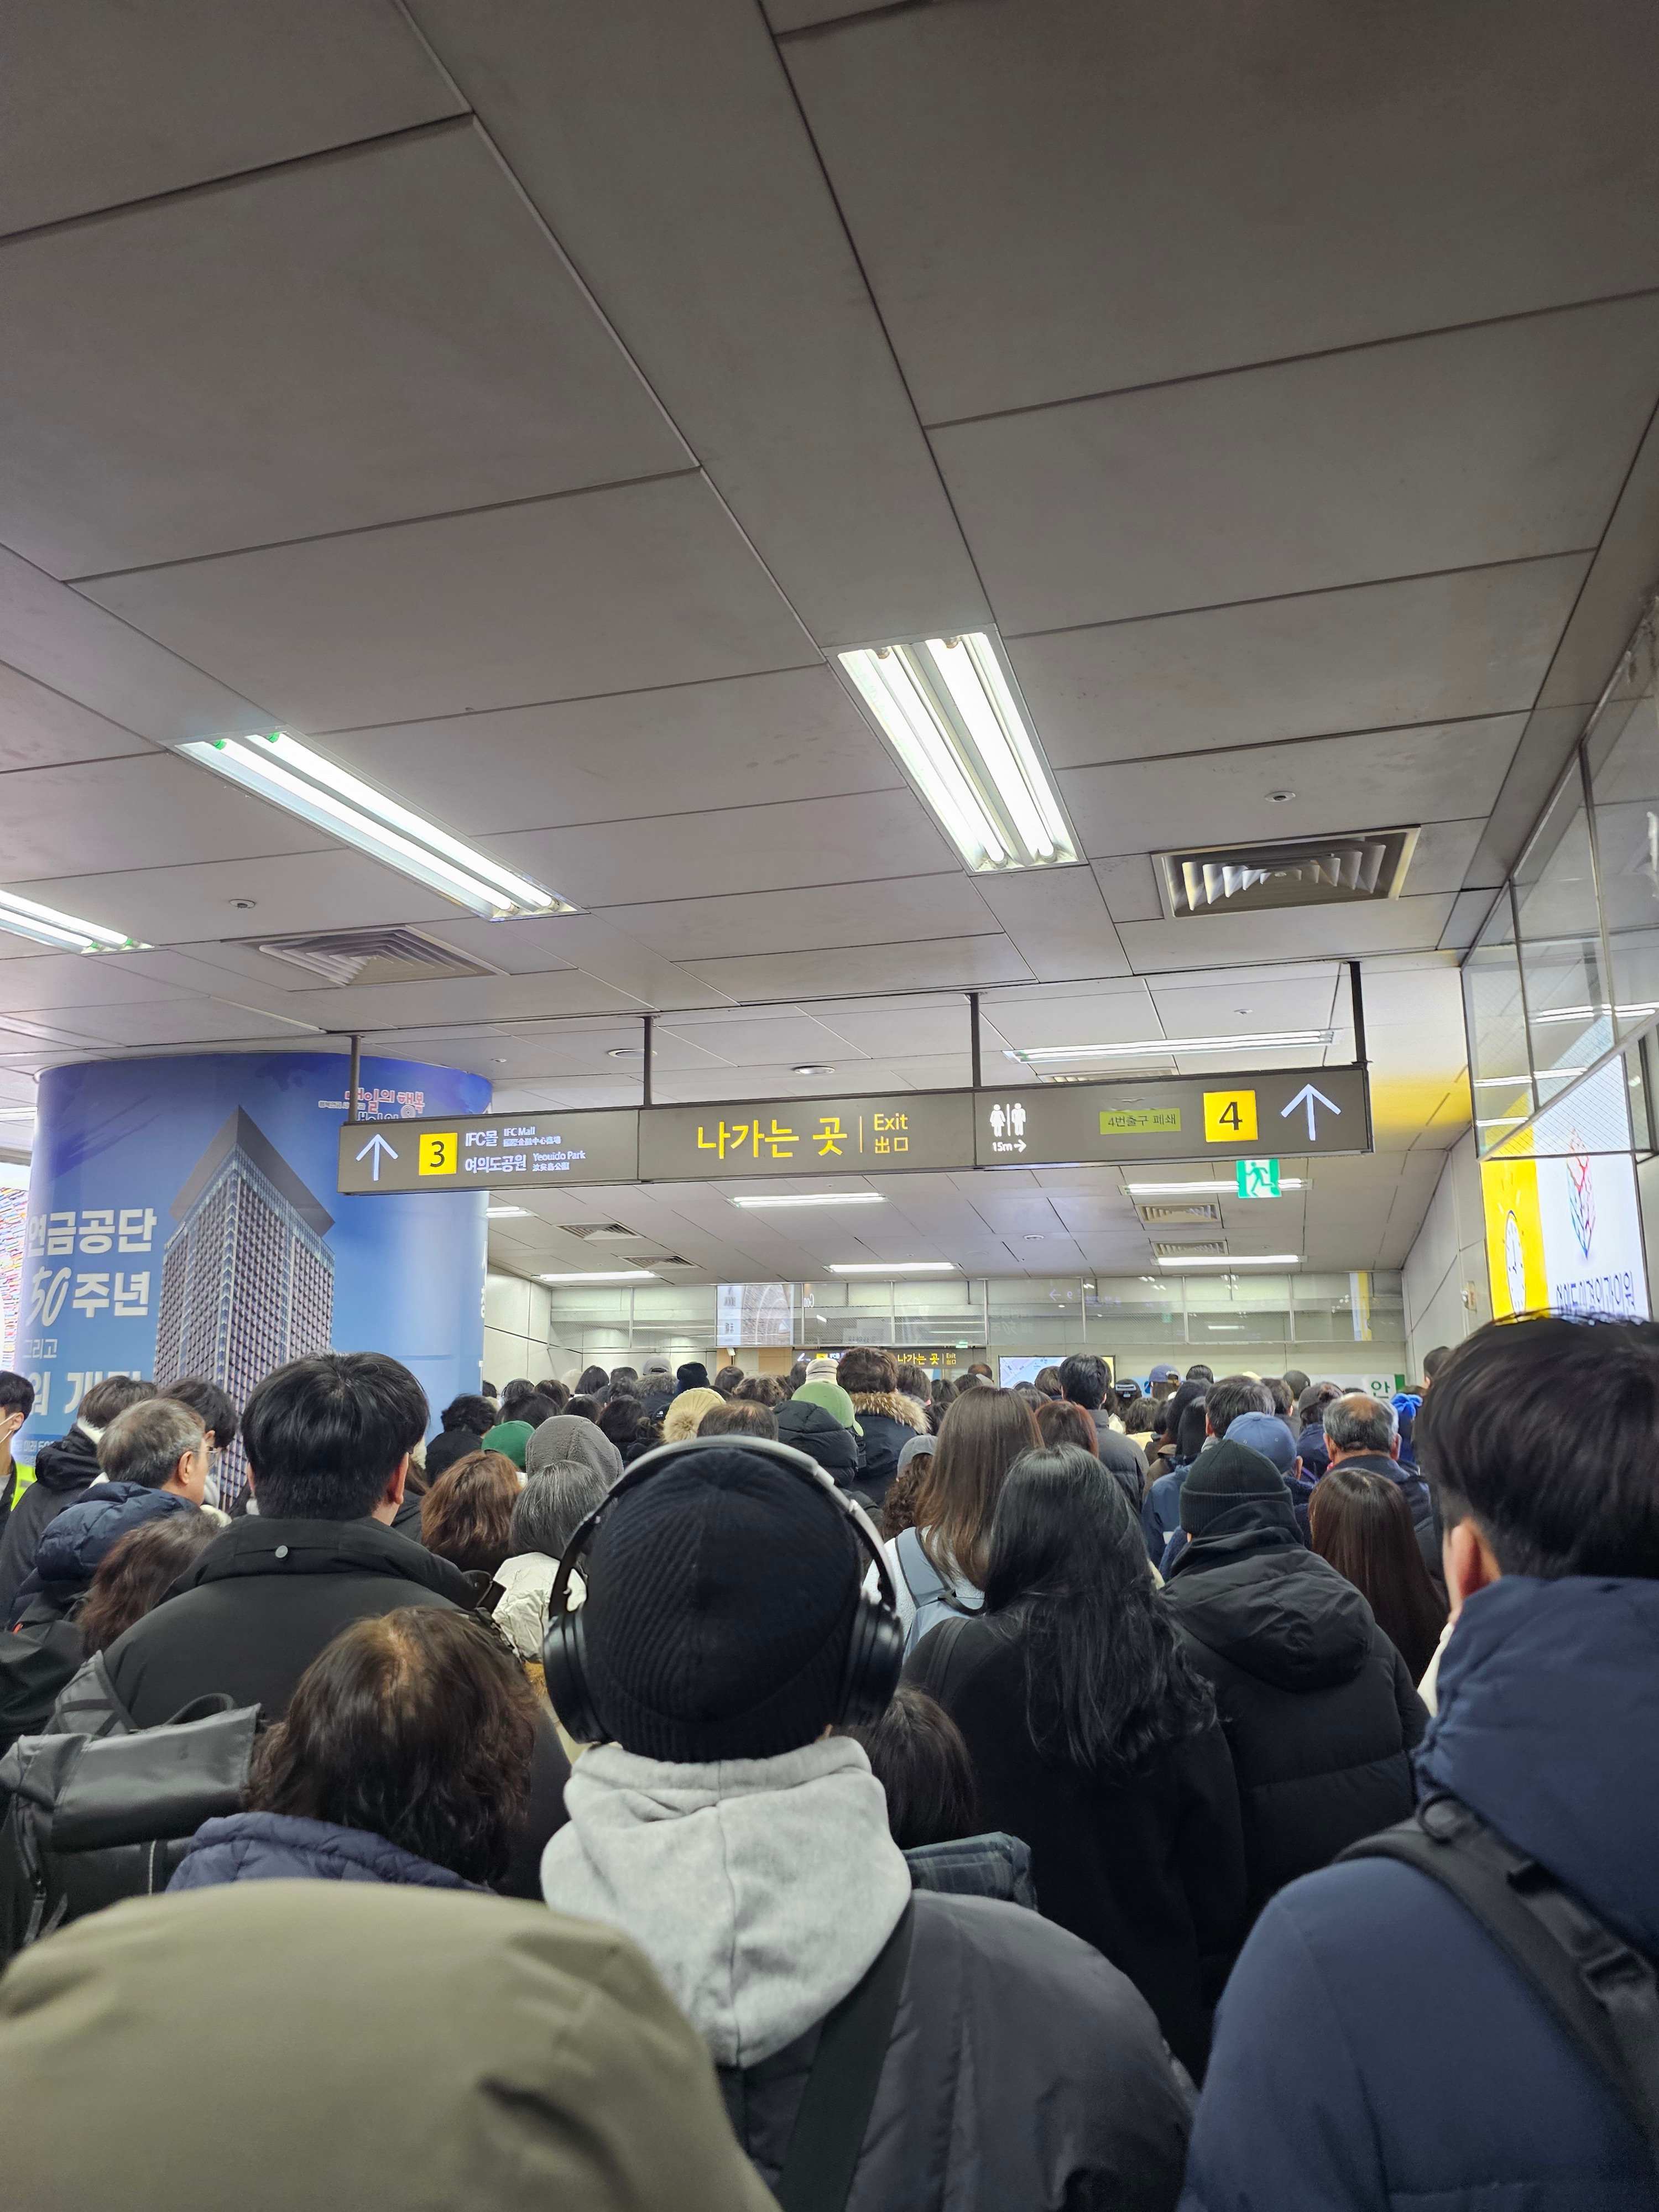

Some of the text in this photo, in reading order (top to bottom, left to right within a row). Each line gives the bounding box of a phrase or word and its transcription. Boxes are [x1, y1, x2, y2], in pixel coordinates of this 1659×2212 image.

[874, 1113, 908, 1131] Exit
[1108, 1113, 1176, 1127] 4번출구 폐쇄
[1219, 1102, 1243, 1130] 4
[465, 1130, 498, 1147] IFC몰
[504, 1126, 536, 1136] IFC Mall
[698, 1117, 847, 1159] 나가는 곳
[874, 1135, 909, 1154] 出口
[993, 1141, 1013, 1152] 15m
[430, 1141, 445, 1167] 3
[533, 1150, 586, 1162] Yeouido Park
[465, 1154, 527, 1173] 여의도공원
[25, 1266, 150, 1327] 50주년
[22, 1338, 58, 1360] 그리고
[898, 1353, 939, 1365] 나가는 곳
